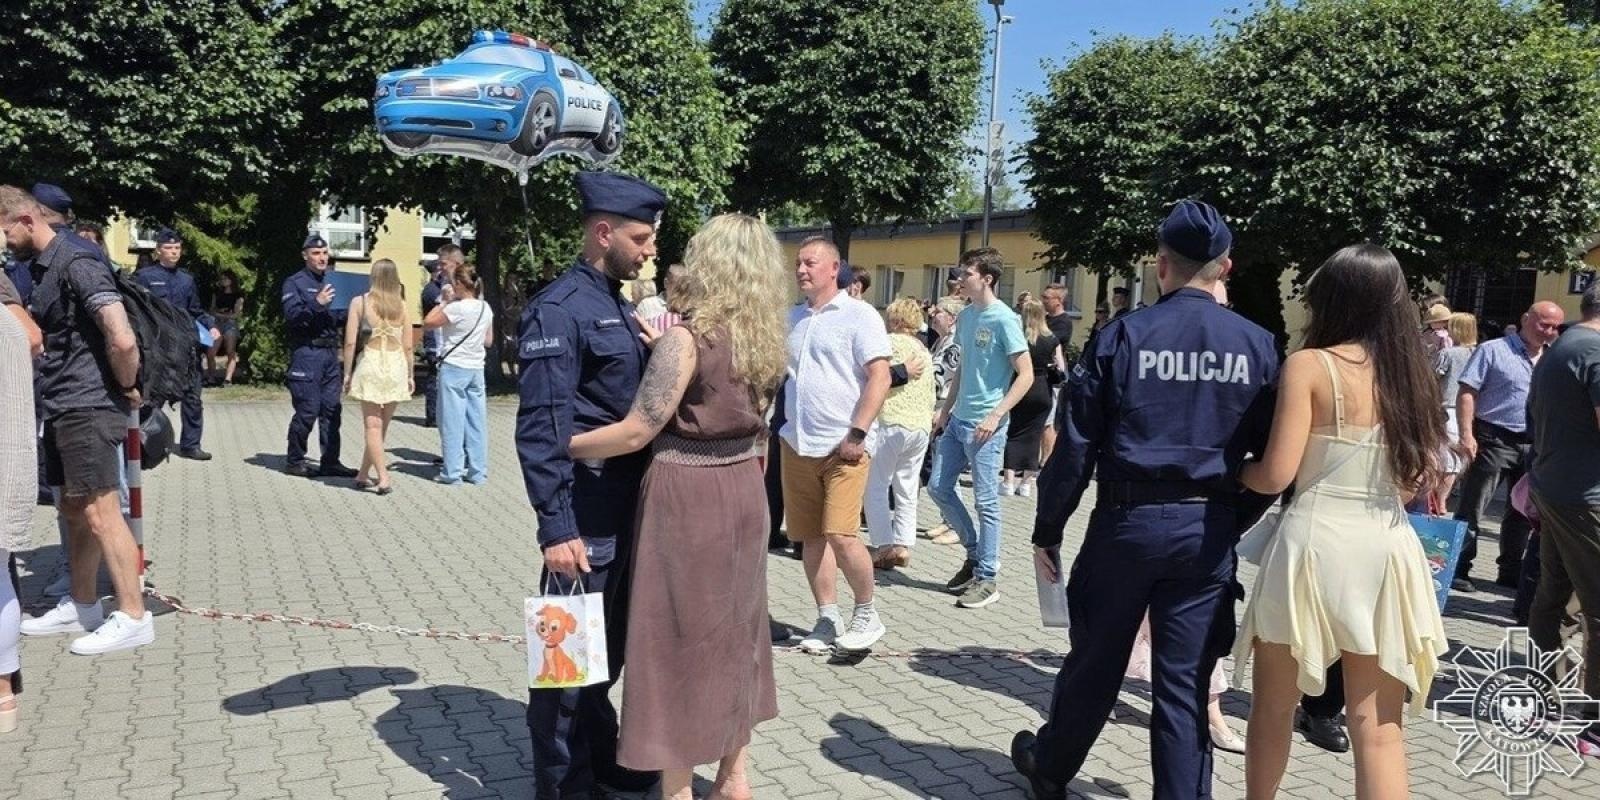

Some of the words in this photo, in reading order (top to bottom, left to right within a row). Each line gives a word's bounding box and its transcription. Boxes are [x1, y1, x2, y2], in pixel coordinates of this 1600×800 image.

[567, 96, 603, 111] POLICE
[525, 337, 561, 353] POLICJA
[1138, 349, 1251, 385] POLICJA
